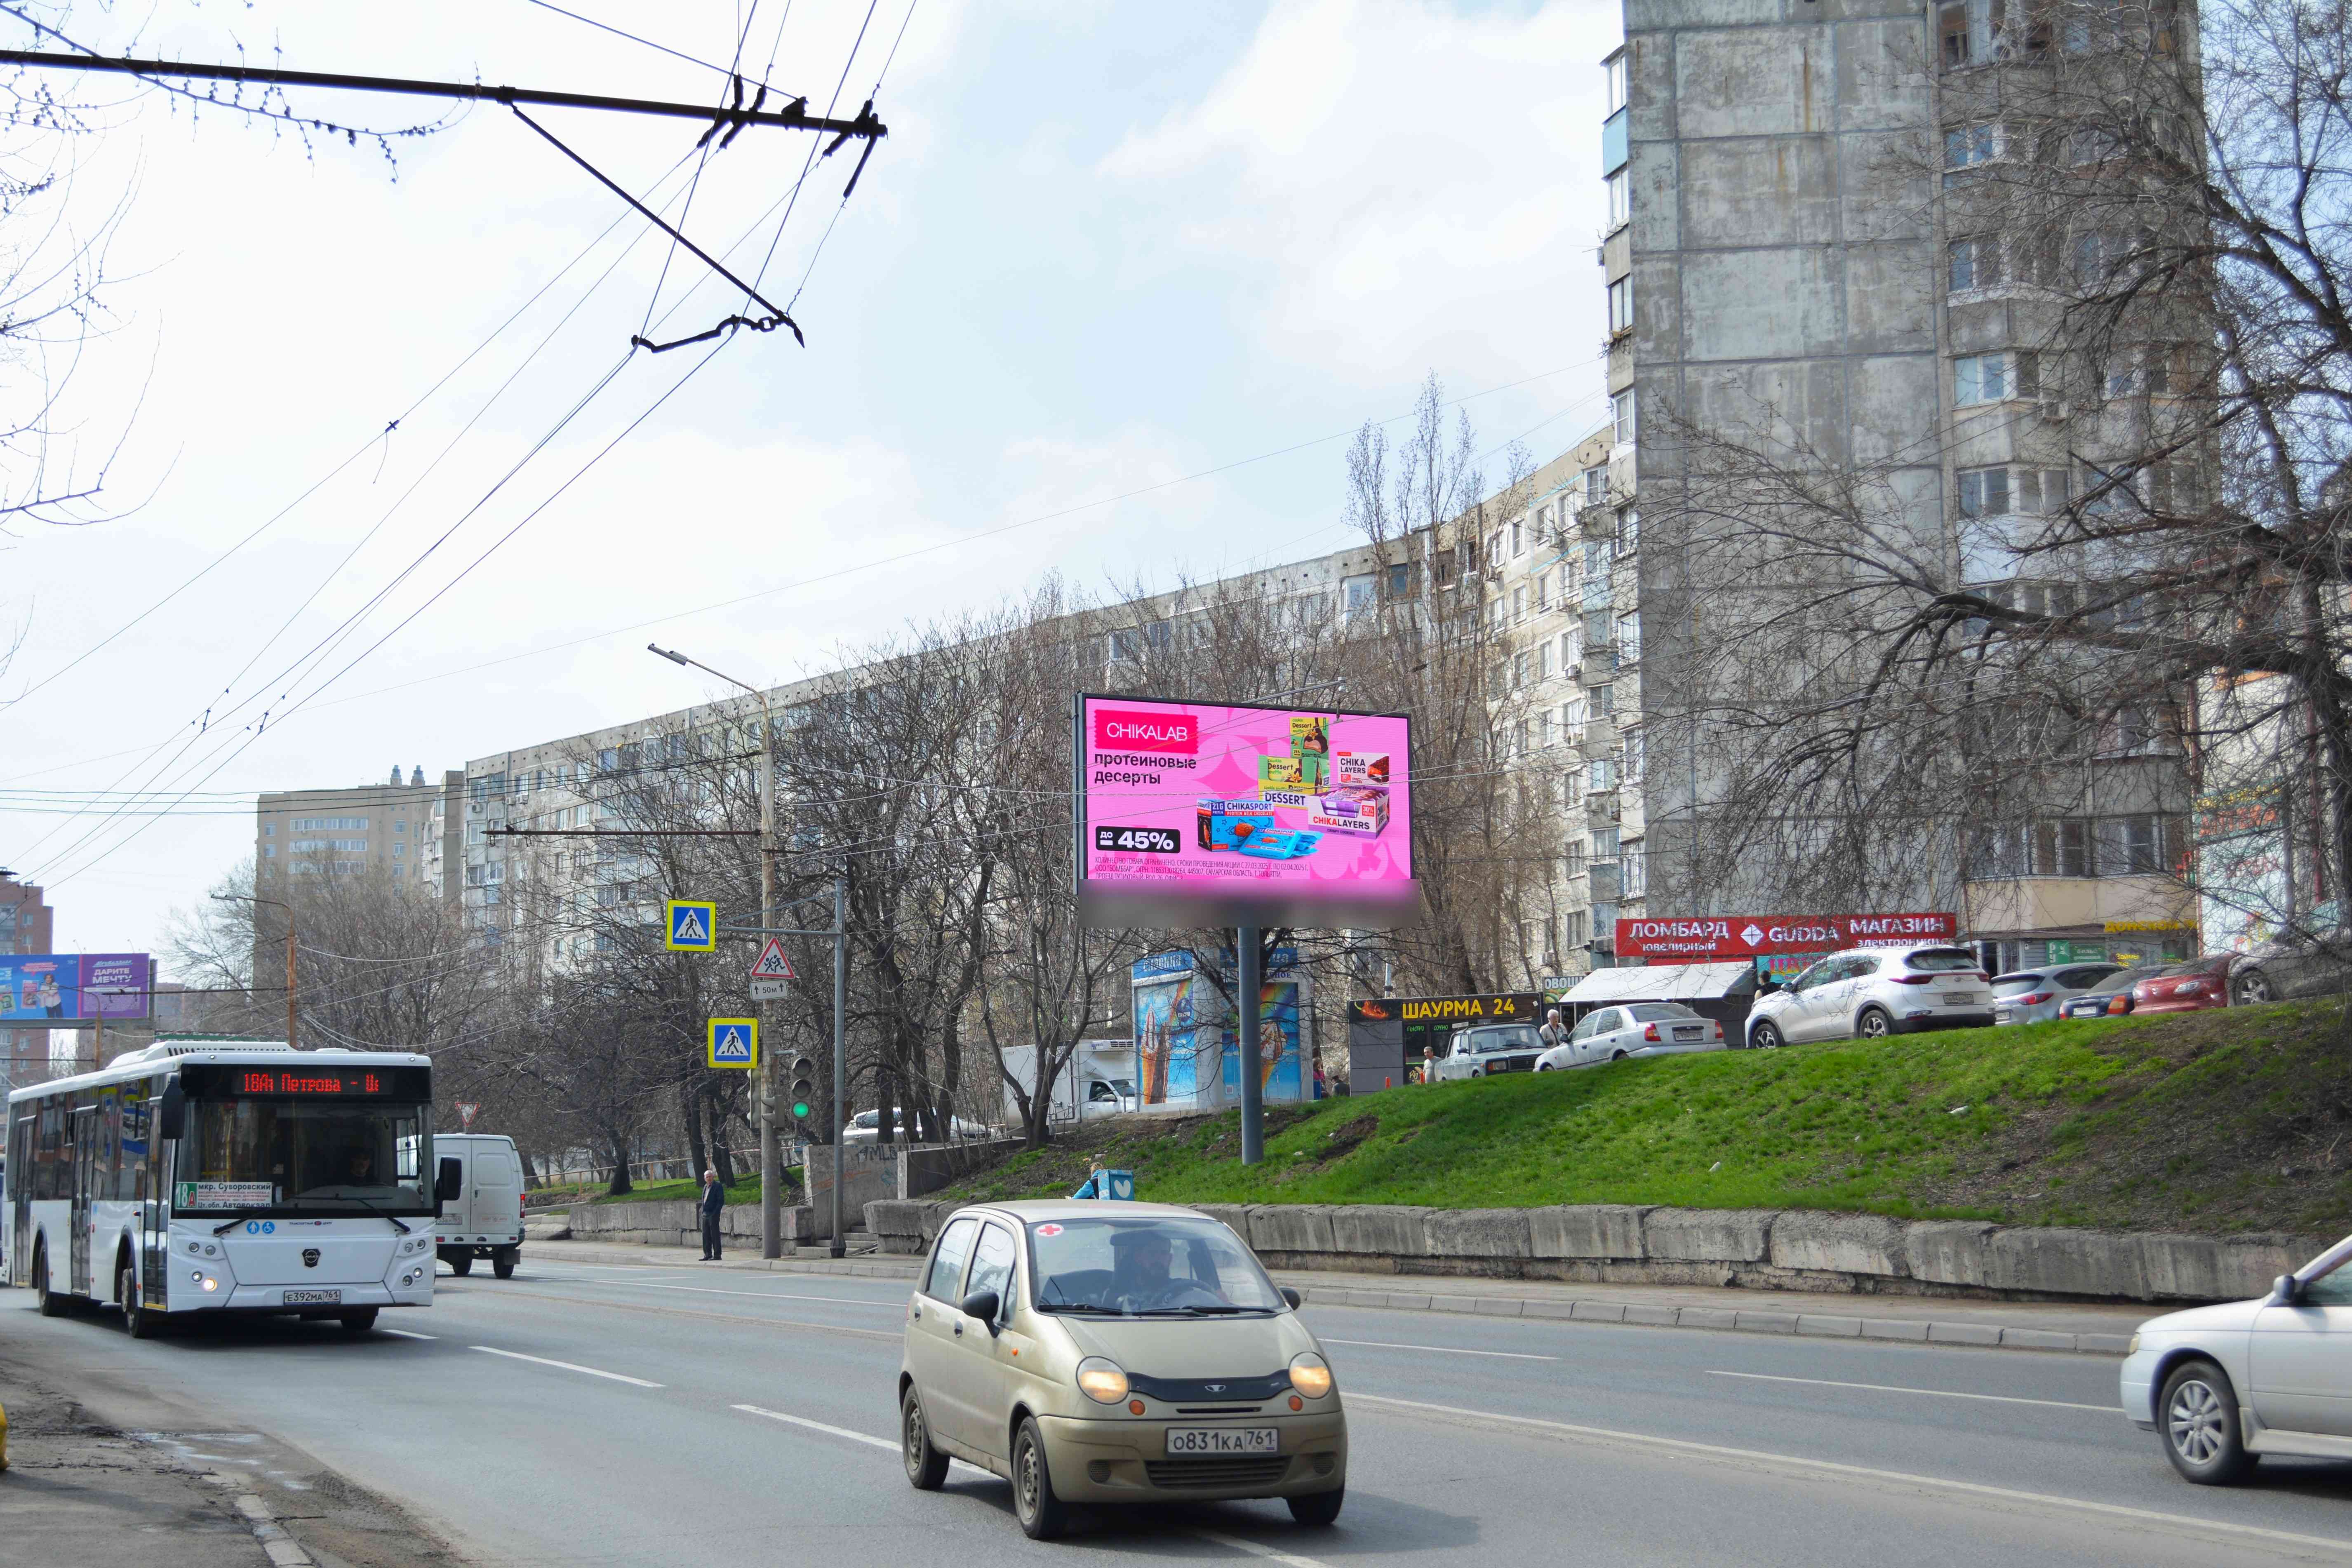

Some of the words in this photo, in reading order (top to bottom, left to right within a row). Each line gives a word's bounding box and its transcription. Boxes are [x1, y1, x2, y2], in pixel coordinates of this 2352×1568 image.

[1107, 722, 1188, 741] CHIKALAB
[1095, 754, 1197, 769] протеиновые
[1341, 758, 1366, 766] CHIKA
[1094, 771, 1160, 786] десерты
[1265, 792, 1305, 805] DESSERT
[1313, 816, 1370, 830] CHIKALAYERS
[1629, 921, 1729, 939] ЛОМБАРД
[1850, 917, 1945, 935] МАГАЗИН
[1769, 926, 1840, 942] GUDDA
[1642, 940, 1716, 952] ювелирный
[92, 975, 132, 984] МЕЧТУ
[1402, 999, 1483, 1019] ШАУРМА
[1494, 998, 1515, 1015] 24
[282, 1074, 341, 1092] Петрова
[219, 1183, 271, 1191] Суворовский
[287, 1292, 322, 1301] Е392МА
[1174, 1432, 1243, 1450] О831КА
[1247, 1431, 1272, 1445] 761
